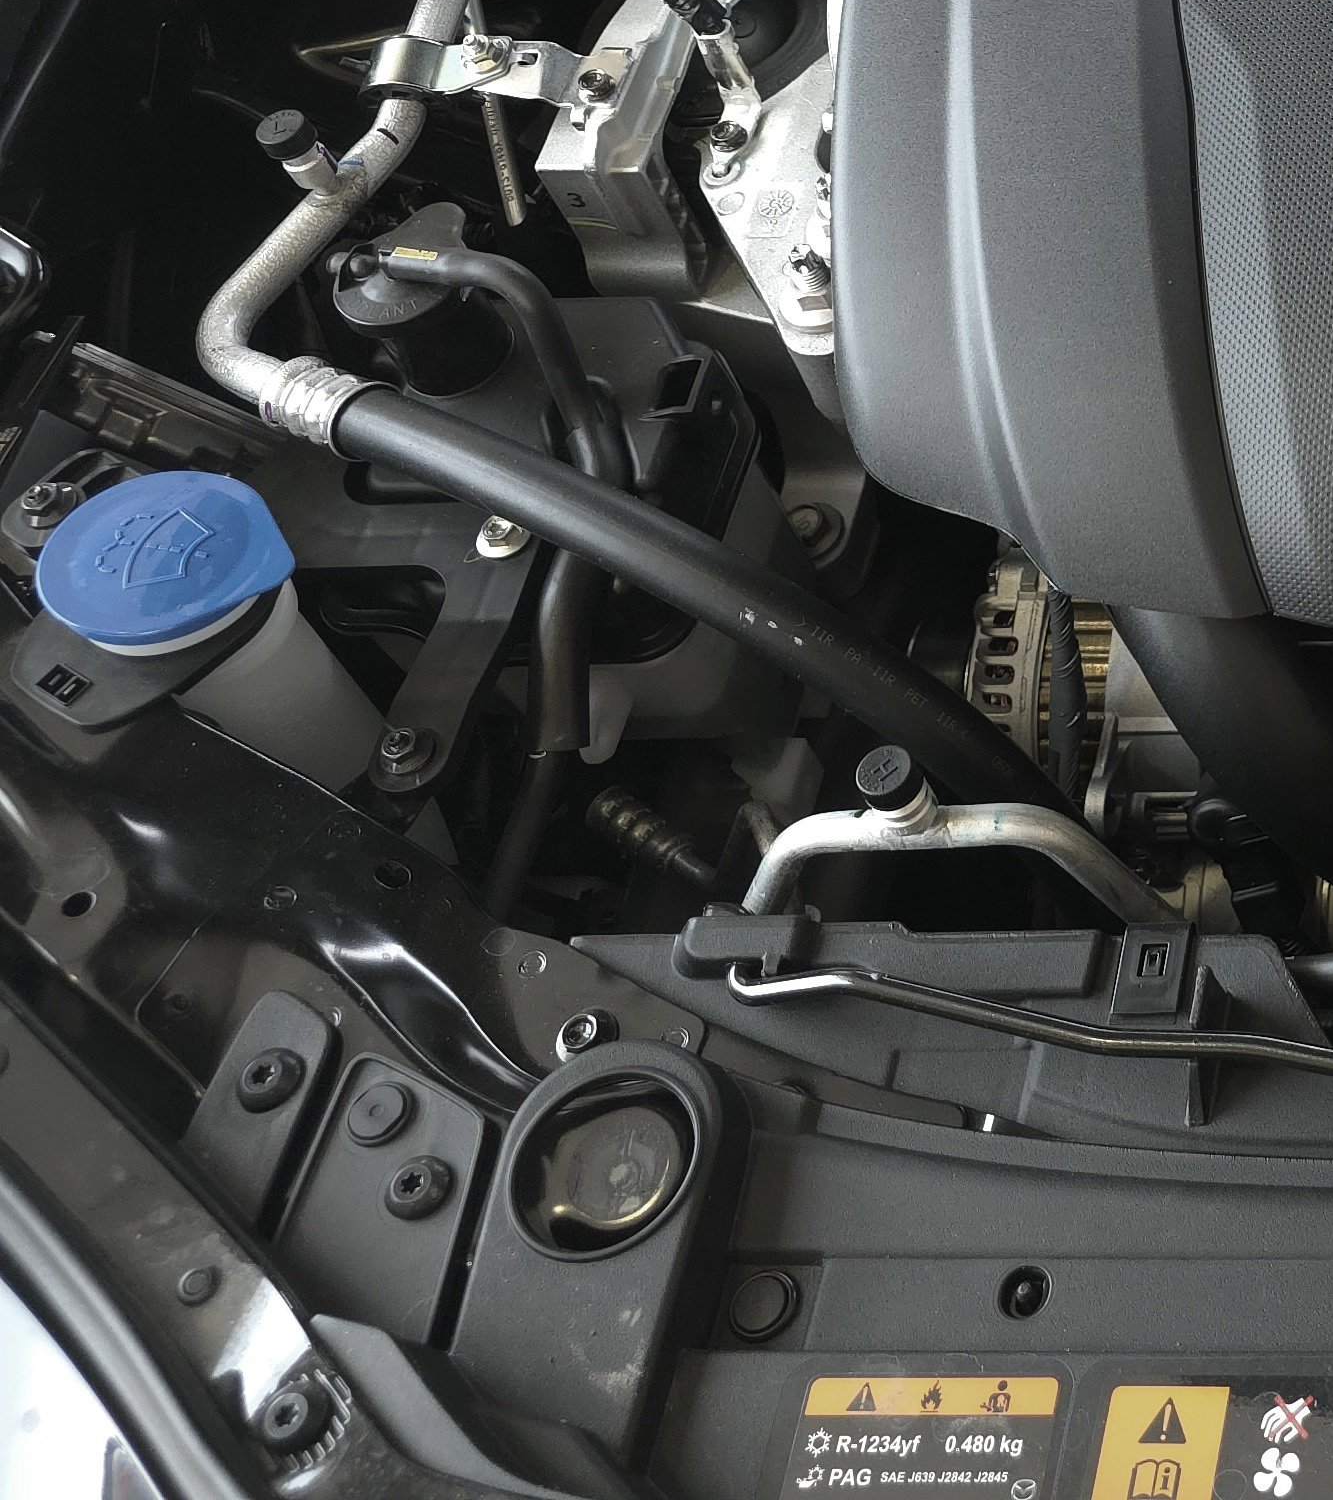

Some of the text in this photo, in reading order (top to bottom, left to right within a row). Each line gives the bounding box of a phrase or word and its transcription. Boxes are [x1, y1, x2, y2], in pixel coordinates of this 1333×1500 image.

[836, 1435, 1024, 1457] R-1234yf 0.480 kg
[828, 1468, 1009, 1486] PAG SAE J639 J2842 J2845
